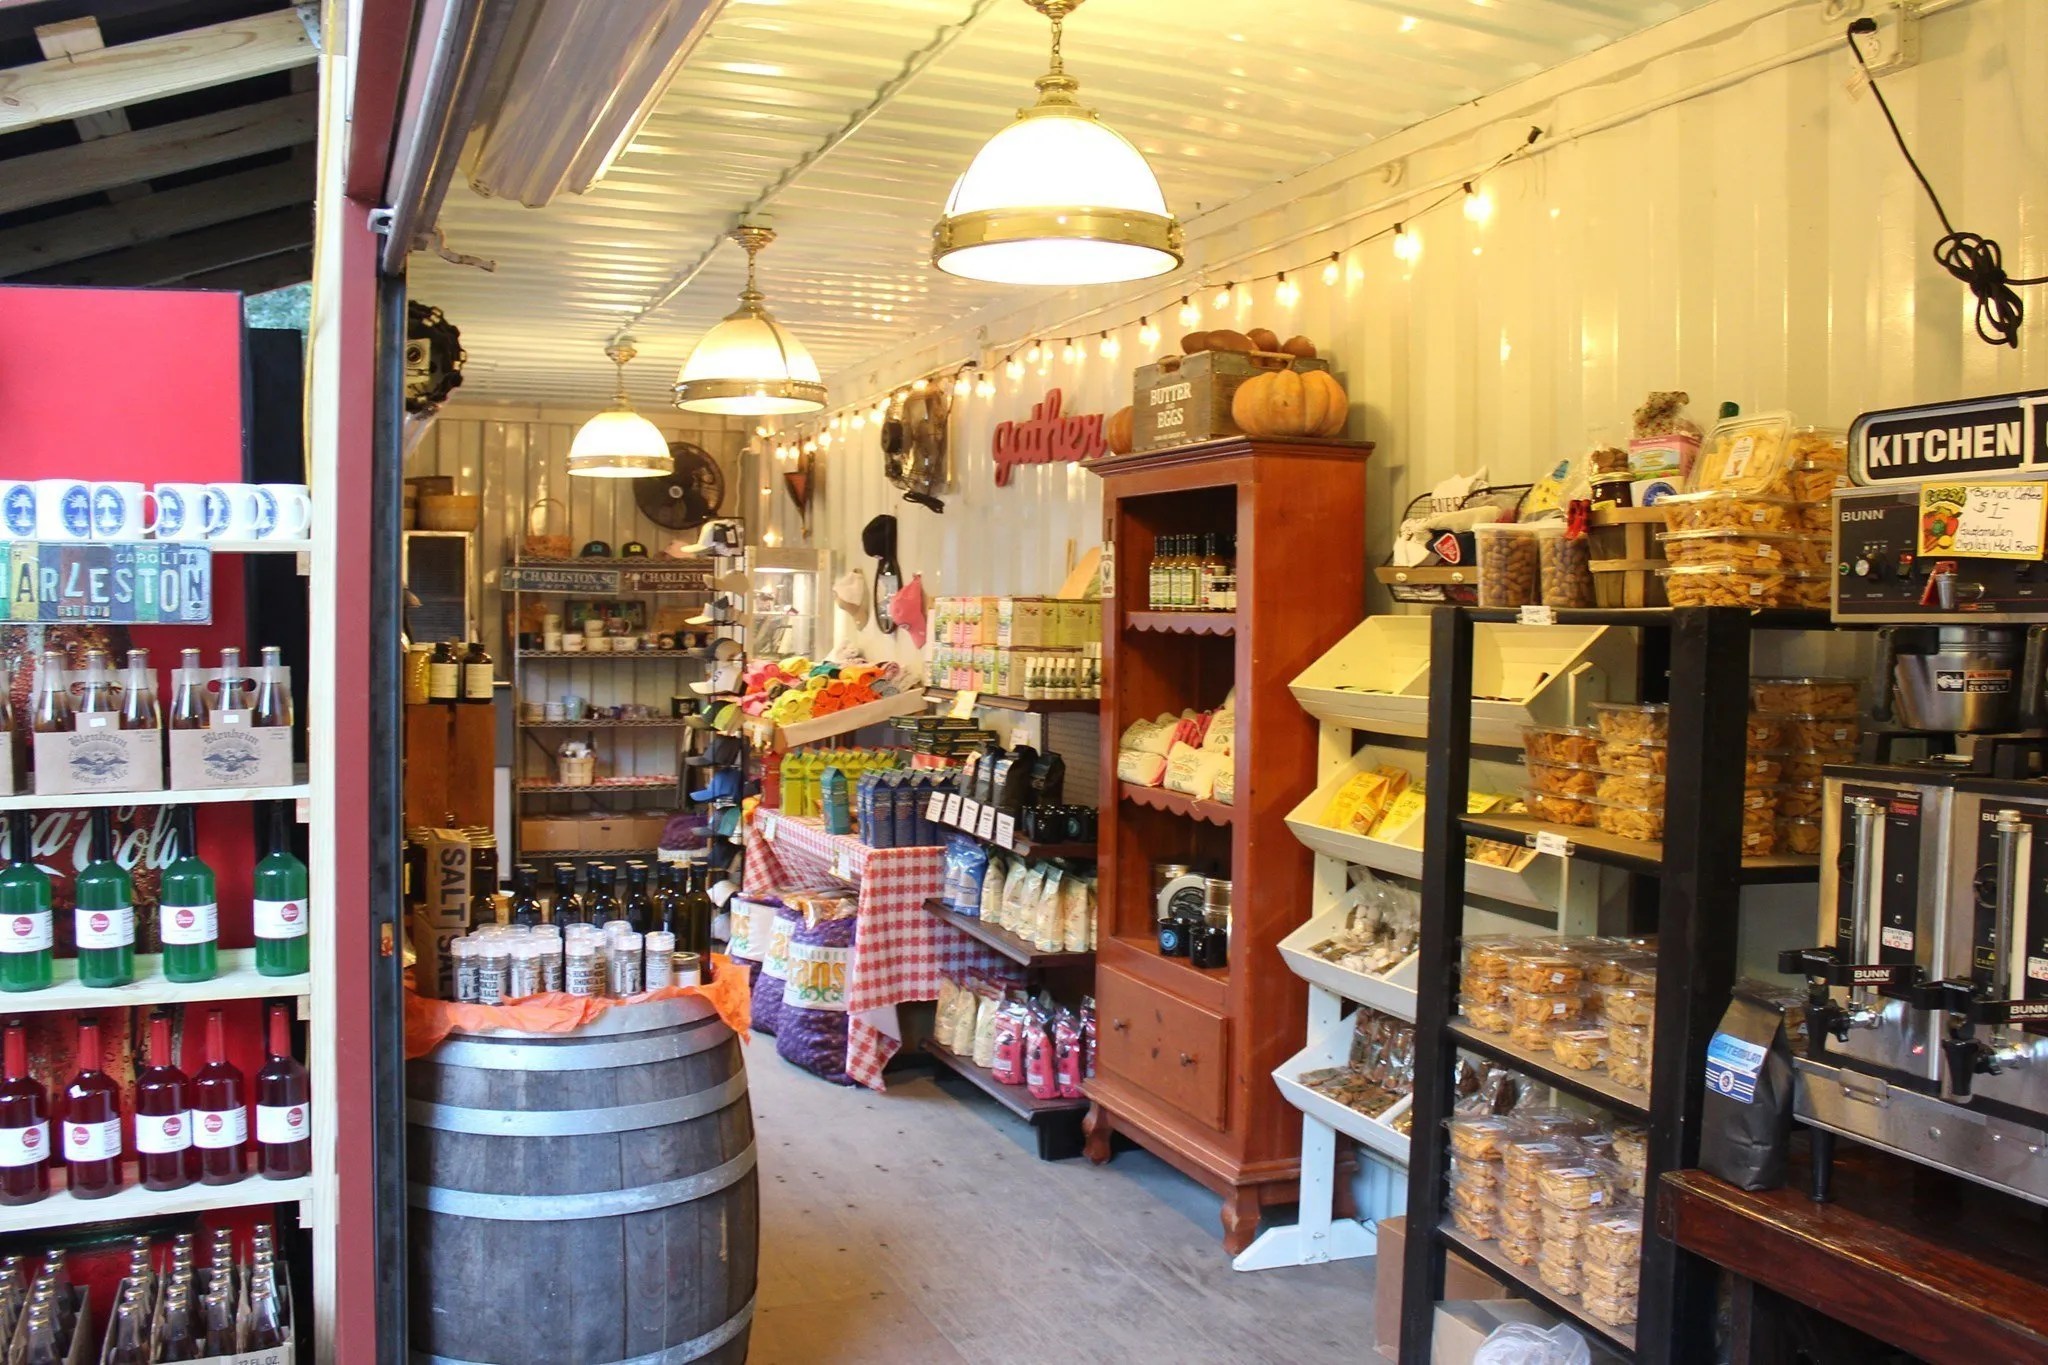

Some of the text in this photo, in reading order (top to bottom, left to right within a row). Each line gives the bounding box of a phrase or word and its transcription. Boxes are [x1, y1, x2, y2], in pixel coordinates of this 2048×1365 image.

[1150, 382, 1192, 406] BUTTER
[1157, 407, 1184, 428] EGGS
[992, 388, 1108, 487] gather
[1869, 422, 2020, 468] KITCHEN
[1841, 510, 1885, 522] BUNN
[641, 572, 705, 585] CHARLESTO
[1982, 812, 1999, 822] BU
[441, 848, 466, 921] SALT
[1885, 939, 1909, 949] HOT
[1854, 969, 1890, 978] BUNN
[2010, 1004, 2048, 1014] BUNN
